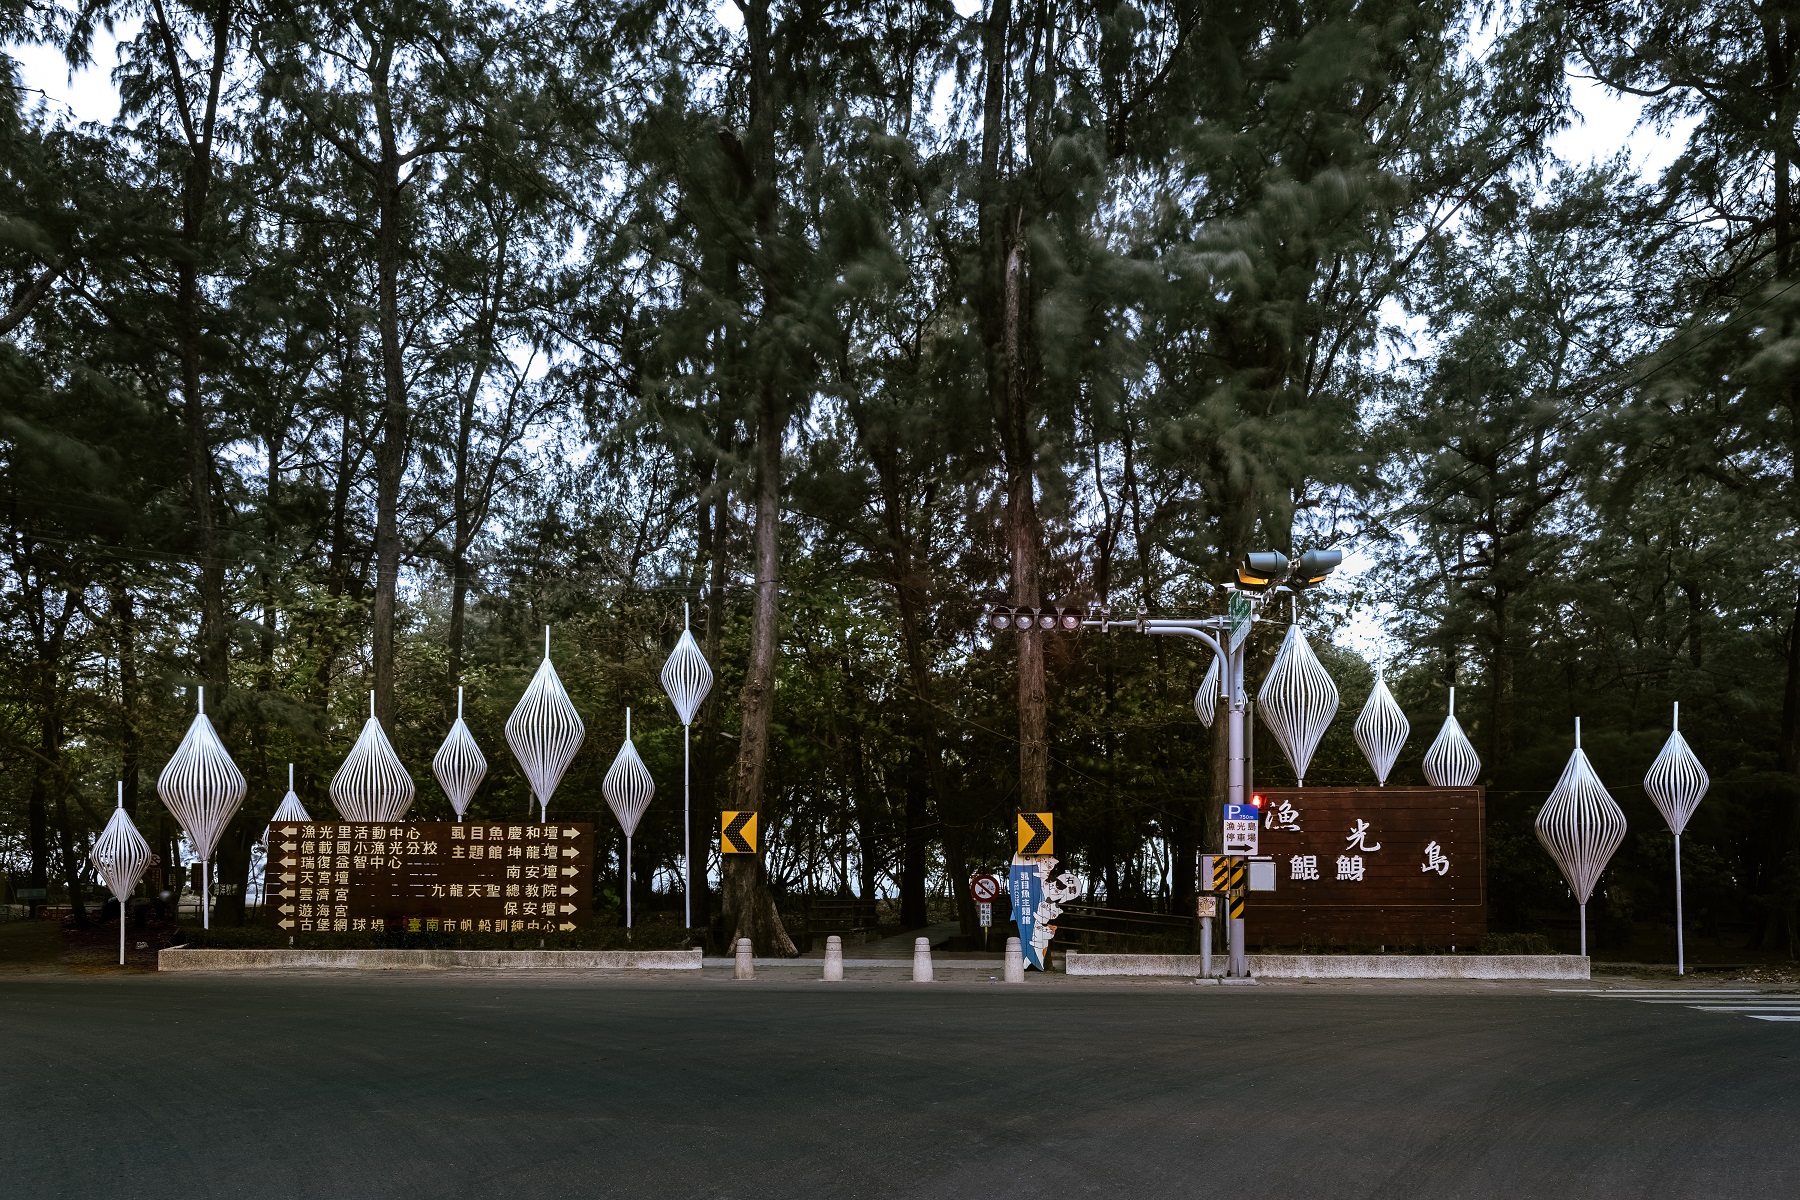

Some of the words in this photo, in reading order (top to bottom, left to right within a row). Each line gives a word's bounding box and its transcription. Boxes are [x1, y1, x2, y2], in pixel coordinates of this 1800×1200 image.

[1228, 805, 1241, 819] P
[301, 825, 421, 840] 漁光里活動中心
[1226, 822, 1256, 831] 漁光島
[1226, 833, 1256, 843] 停車場
[301, 839, 437, 855] 億載國小漁光分校
[300, 855, 402, 870] 瑞復益智中心
[300, 872, 349, 885] 天宮壇
[506, 865, 558, 879] 南安壇
[299, 888, 349, 902] 雲濟宮
[431, 884, 557, 898] 九龍天聖總教院
[1020, 872, 1031, 925] 虱目魚主題館
[298, 904, 348, 918] 遊海宮
[504, 901, 556, 916] 保安壇
[299, 918, 385, 932] 古堡網球場
[407, 918, 556, 933] 臺南市帆船訓練中心
